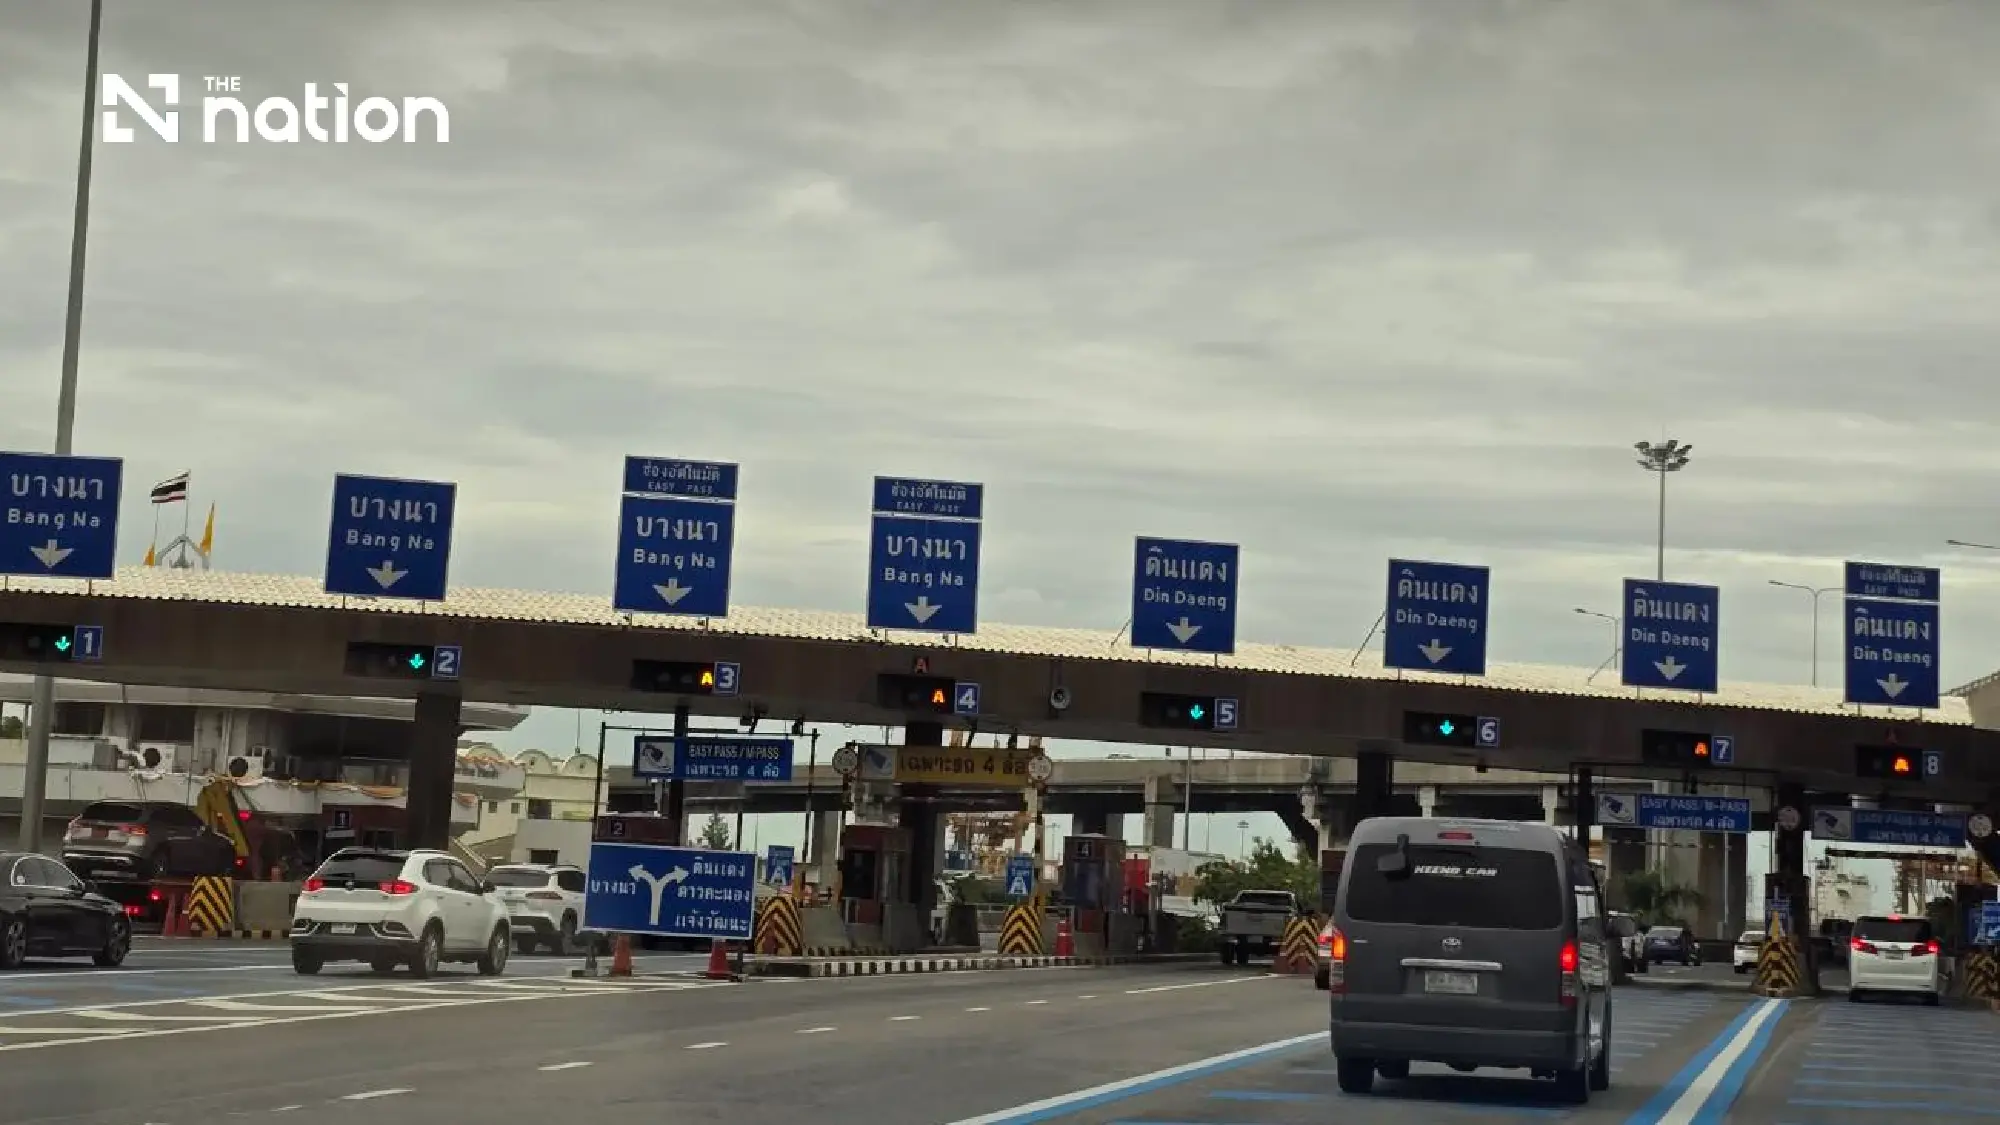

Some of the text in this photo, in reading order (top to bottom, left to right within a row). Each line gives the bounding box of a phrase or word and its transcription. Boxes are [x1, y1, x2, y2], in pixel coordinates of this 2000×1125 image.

[11, 474, 103, 500] บางนา
[647, 481, 675, 493] EASY
[8, 508, 101, 529] Bang Na
[351, 496, 438, 523] บางนา
[637, 515, 719, 542] บางนา
[346, 529, 435, 551] Bang Na
[886, 534, 966, 561] บางนา
[633, 548, 716, 570] Bang Na
[1146, 545, 1227, 583] ดินแดง
[884, 567, 964, 589] Bang Na
[1398, 568, 1478, 604] ดินแดง
[1144, 586, 1227, 612] Din Daeng
[1634, 587, 1710, 623] ดินแดง
[1395, 608, 1478, 634] Din Daeng
[1855, 607, 1931, 640] ดินแดง
[83, 631, 93, 654] 1
[1631, 627, 1710, 652] Din Daeng
[436, 651, 455, 673] 2
[1853, 645, 1932, 667] Din Daeng
[702, 671, 715, 686] A
[719, 666, 735, 689] 3
[932, 688, 946, 703] A
[958, 687, 977, 709] 4
[1218, 702, 1234, 725] 5
[1479, 721, 1495, 743] 6
[1694, 742, 1709, 756] A
[1716, 738, 1730, 760] 7
[1927, 753, 1939, 775] 8
[693, 856, 746, 877] ดินแดง
[591, 878, 637, 896] บางนา
[677, 883, 751, 902] ดาวคะนอง
